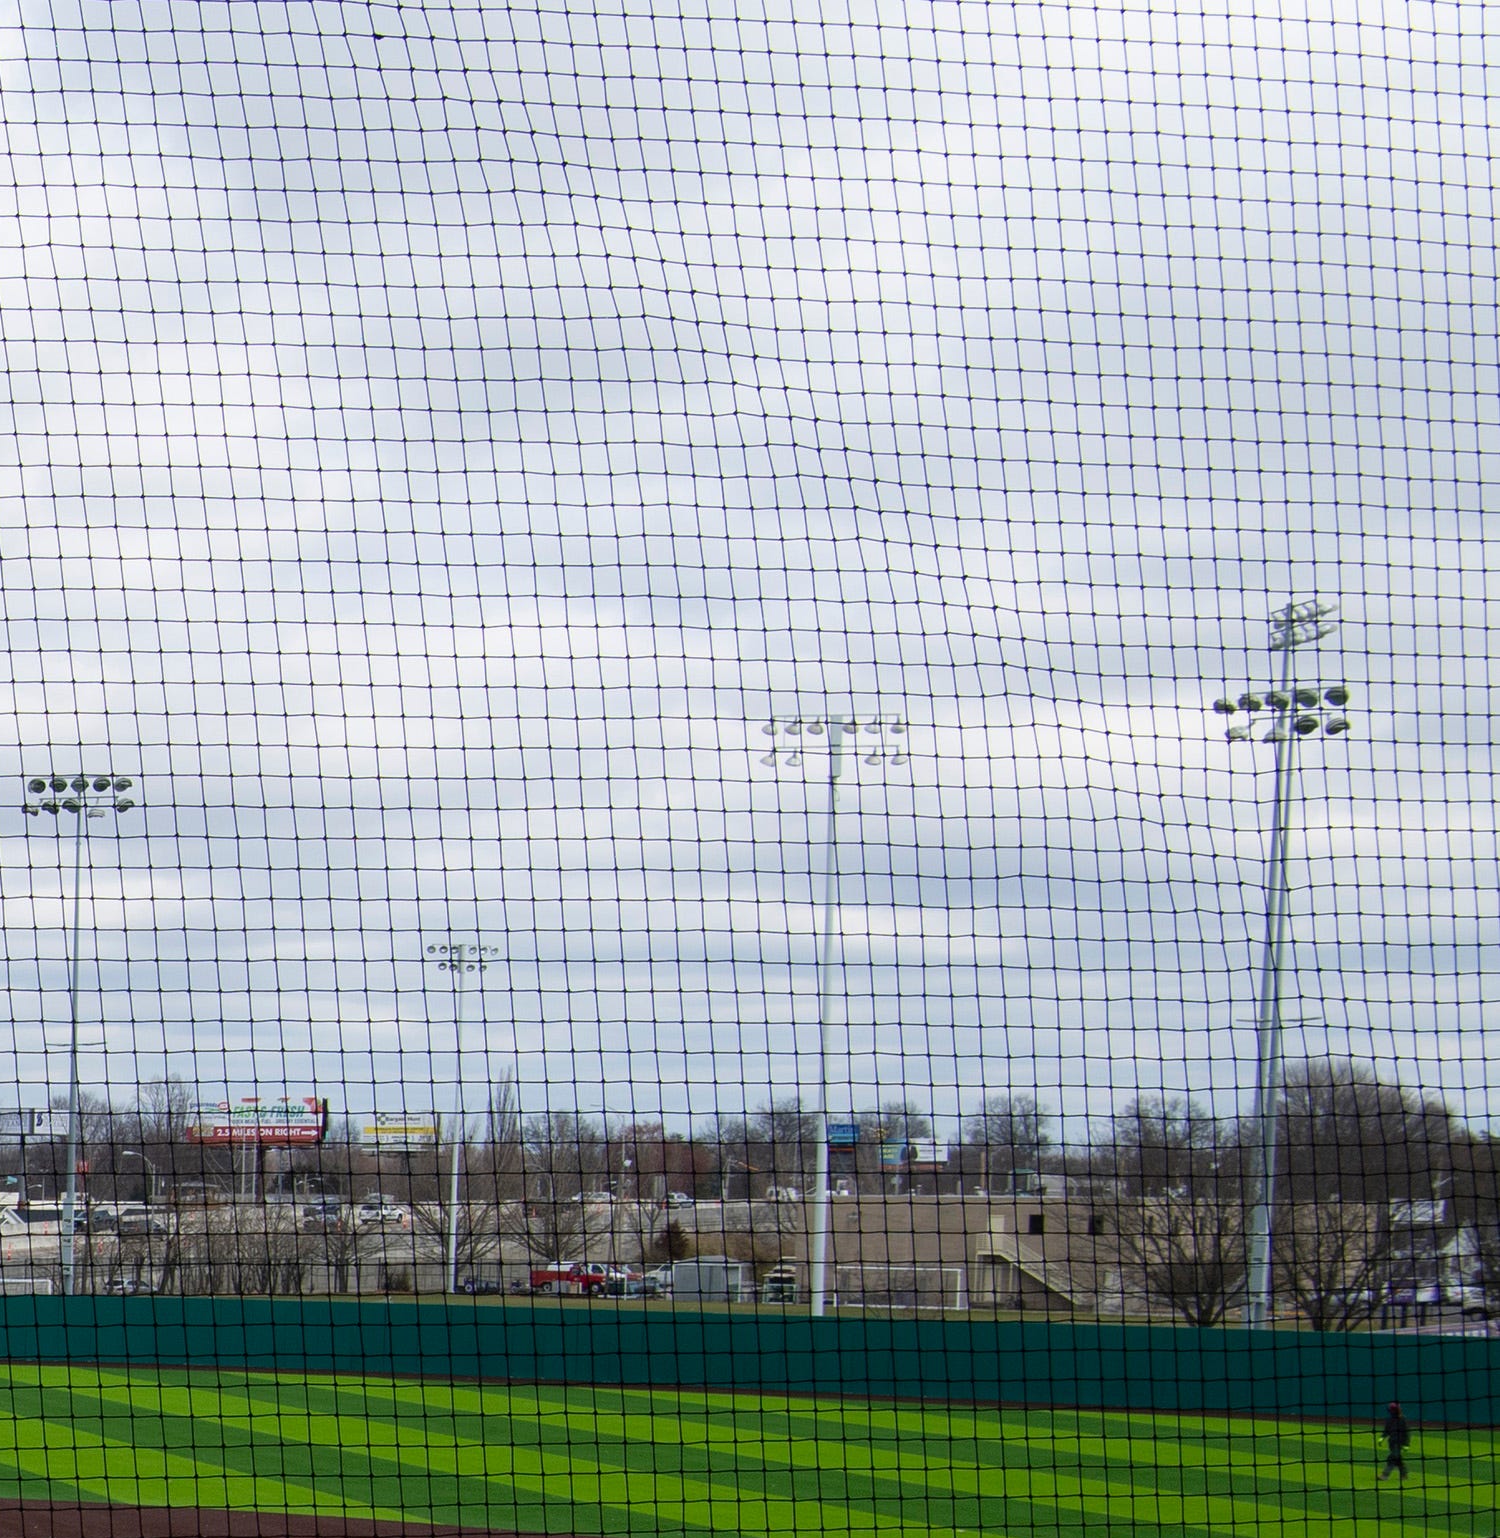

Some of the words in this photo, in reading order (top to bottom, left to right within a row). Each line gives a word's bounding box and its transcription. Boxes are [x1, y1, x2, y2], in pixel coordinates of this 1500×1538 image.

[217, 1128, 230, 1136] 2.5
[232, 1128, 256, 1137] MILES
[259, 1128, 271, 1137] ON
[274, 1128, 301, 1136] RIGHT
